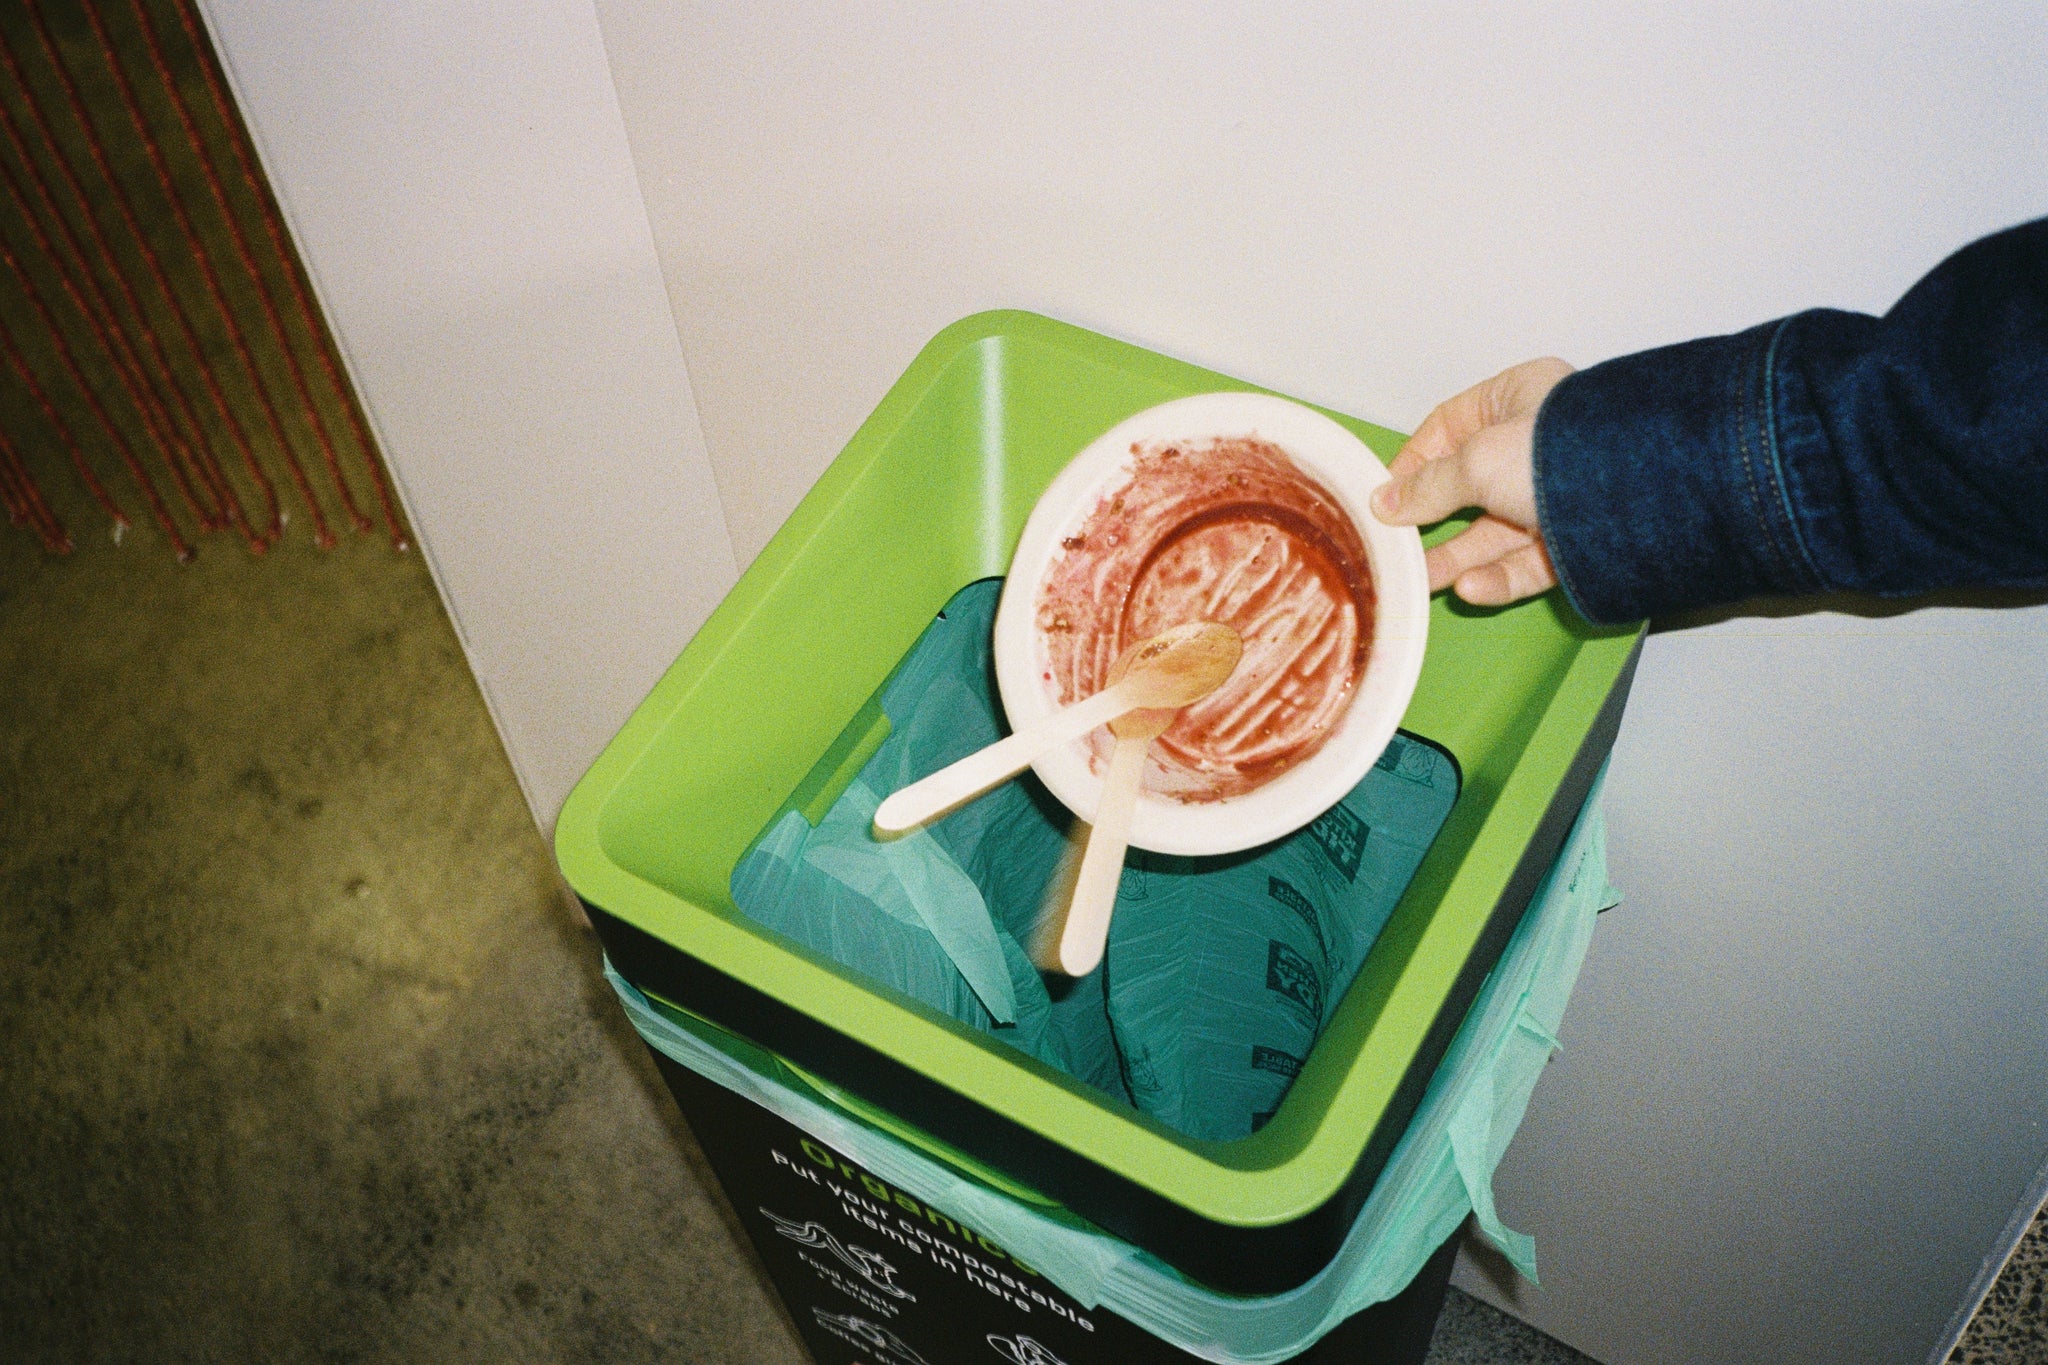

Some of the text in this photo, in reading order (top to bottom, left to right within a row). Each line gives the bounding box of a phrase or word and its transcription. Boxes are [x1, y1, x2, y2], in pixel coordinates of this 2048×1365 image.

[770, 1148, 1096, 1333] Put your compostable
[930, 1248, 958, 1273] in
[965, 1267, 1032, 1313] here
